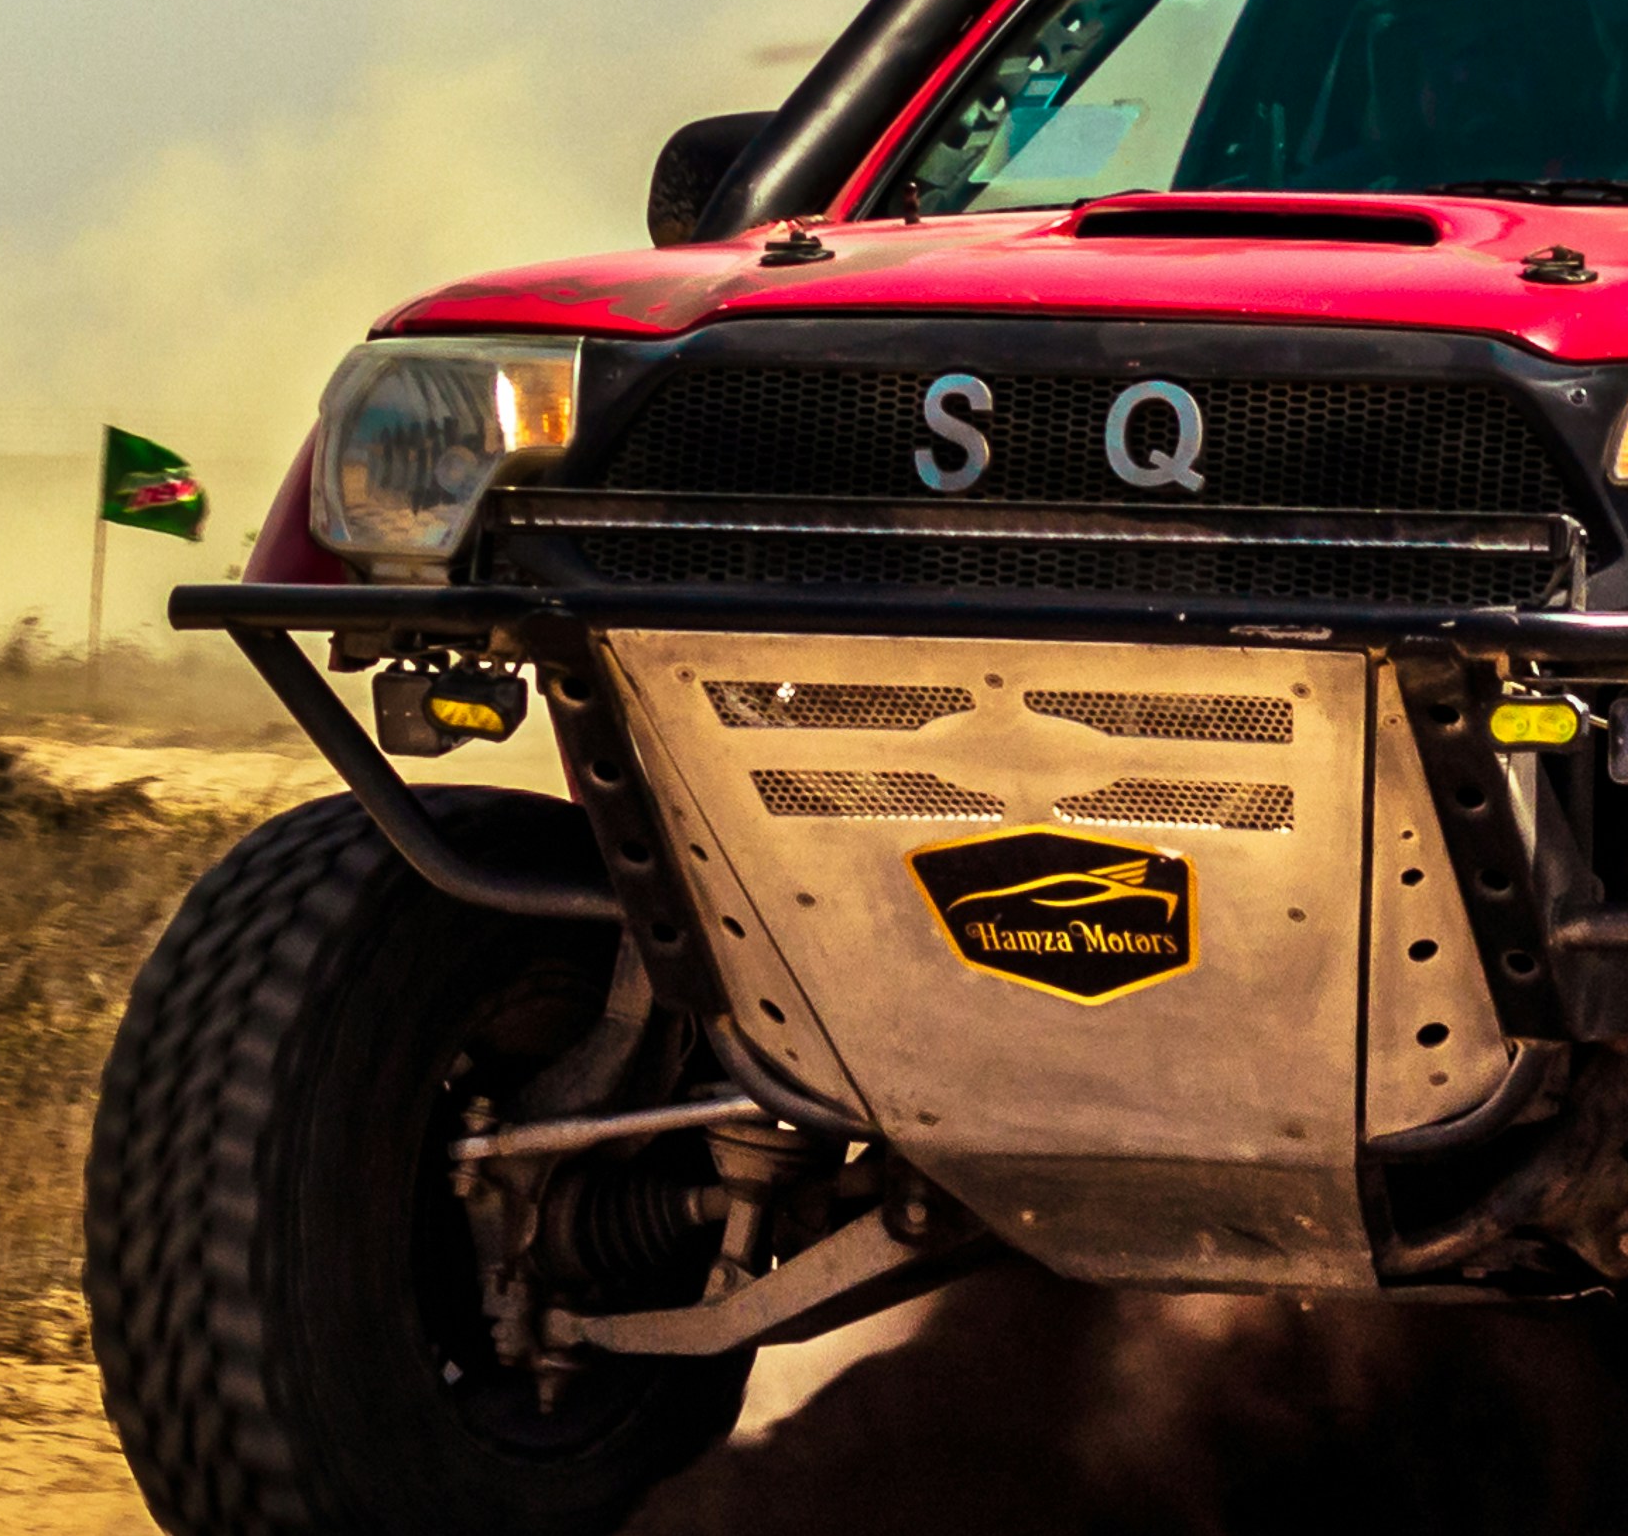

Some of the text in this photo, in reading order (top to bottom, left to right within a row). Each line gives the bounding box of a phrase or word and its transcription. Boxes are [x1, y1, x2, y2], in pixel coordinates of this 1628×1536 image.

[913, 372, 1206, 493] S Q
[966, 920, 1178, 955] Hamza Motors
